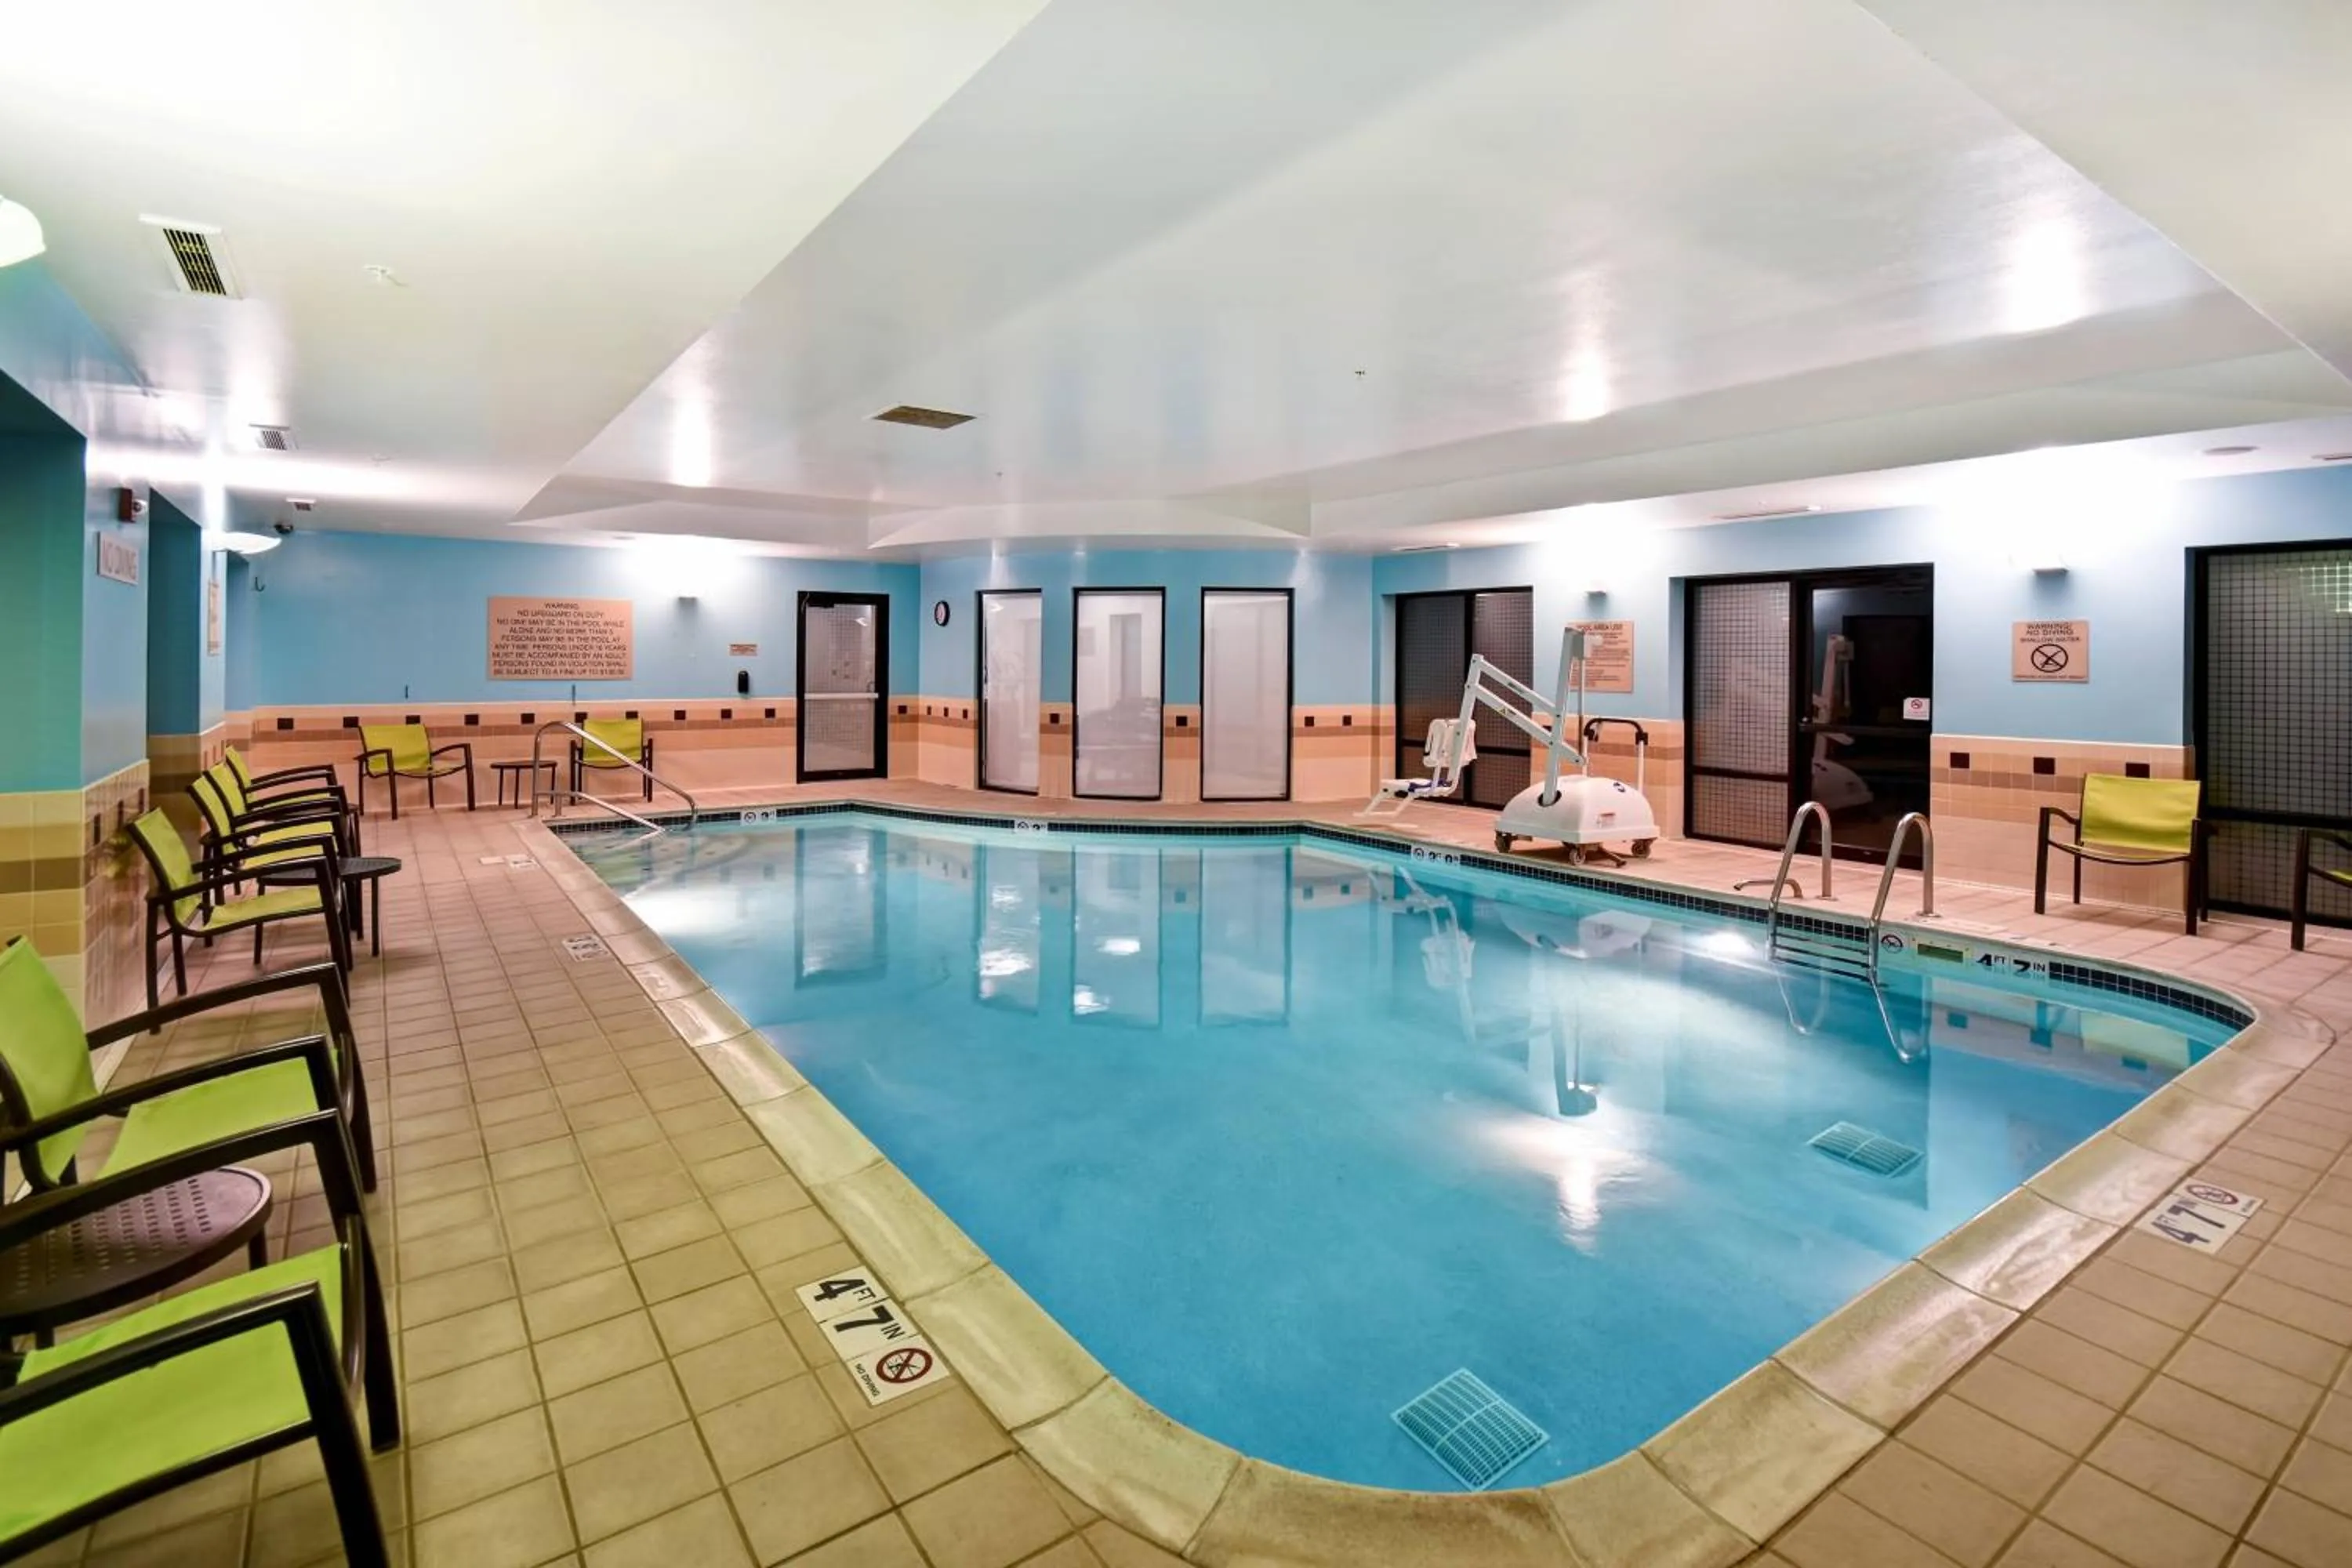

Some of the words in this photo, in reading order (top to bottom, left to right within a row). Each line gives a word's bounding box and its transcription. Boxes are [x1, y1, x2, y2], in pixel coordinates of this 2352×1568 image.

[1976, 953, 1992, 966] 4
[1994, 955, 2006, 965] FT
[2033, 963, 2045, 972] IN
[2167, 1204, 2227, 1229] 7
[2151, 1221, 2211, 1243] 4
[813, 1278, 866, 1301] 4
[852, 1286, 877, 1302] FT
[833, 1304, 895, 1333] 7
[880, 1322, 906, 1341] IN
[855, 1363, 865, 1380] NO
